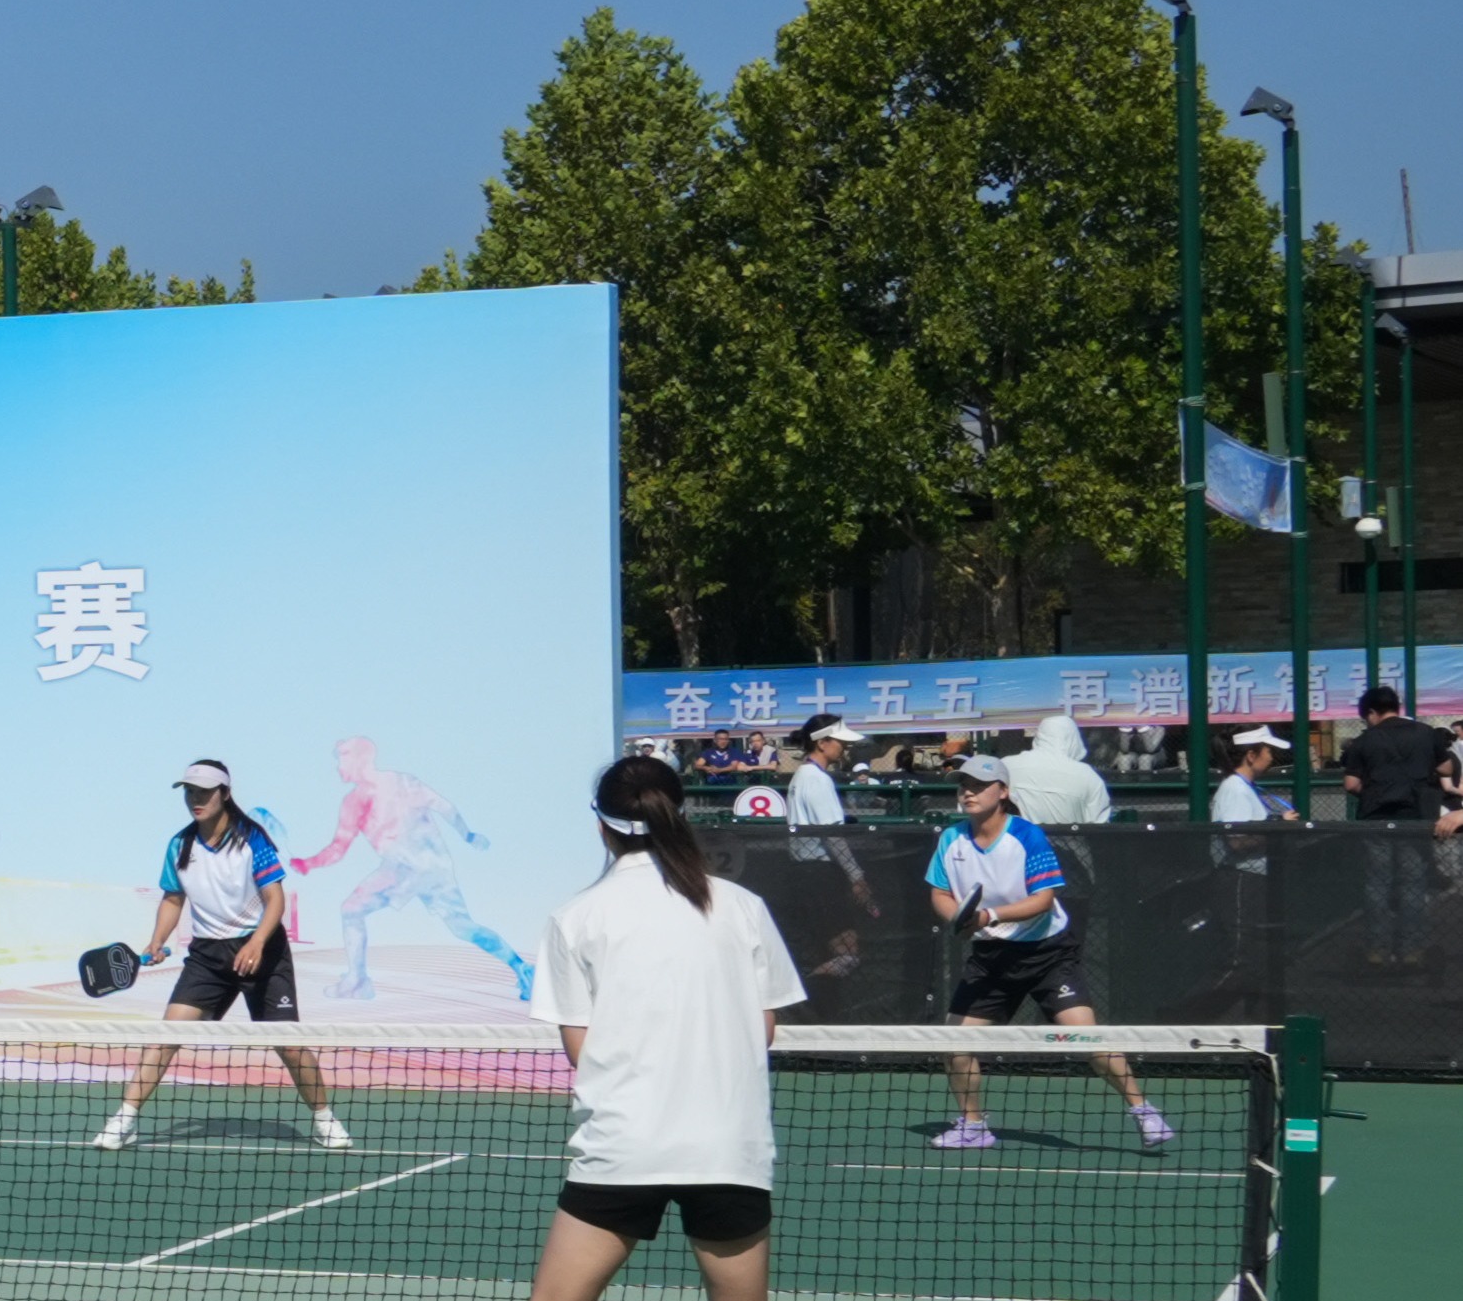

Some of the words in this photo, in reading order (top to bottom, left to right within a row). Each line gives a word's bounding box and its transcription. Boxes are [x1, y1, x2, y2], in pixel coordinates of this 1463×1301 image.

[664, 676, 984, 729] 奋进十五五
